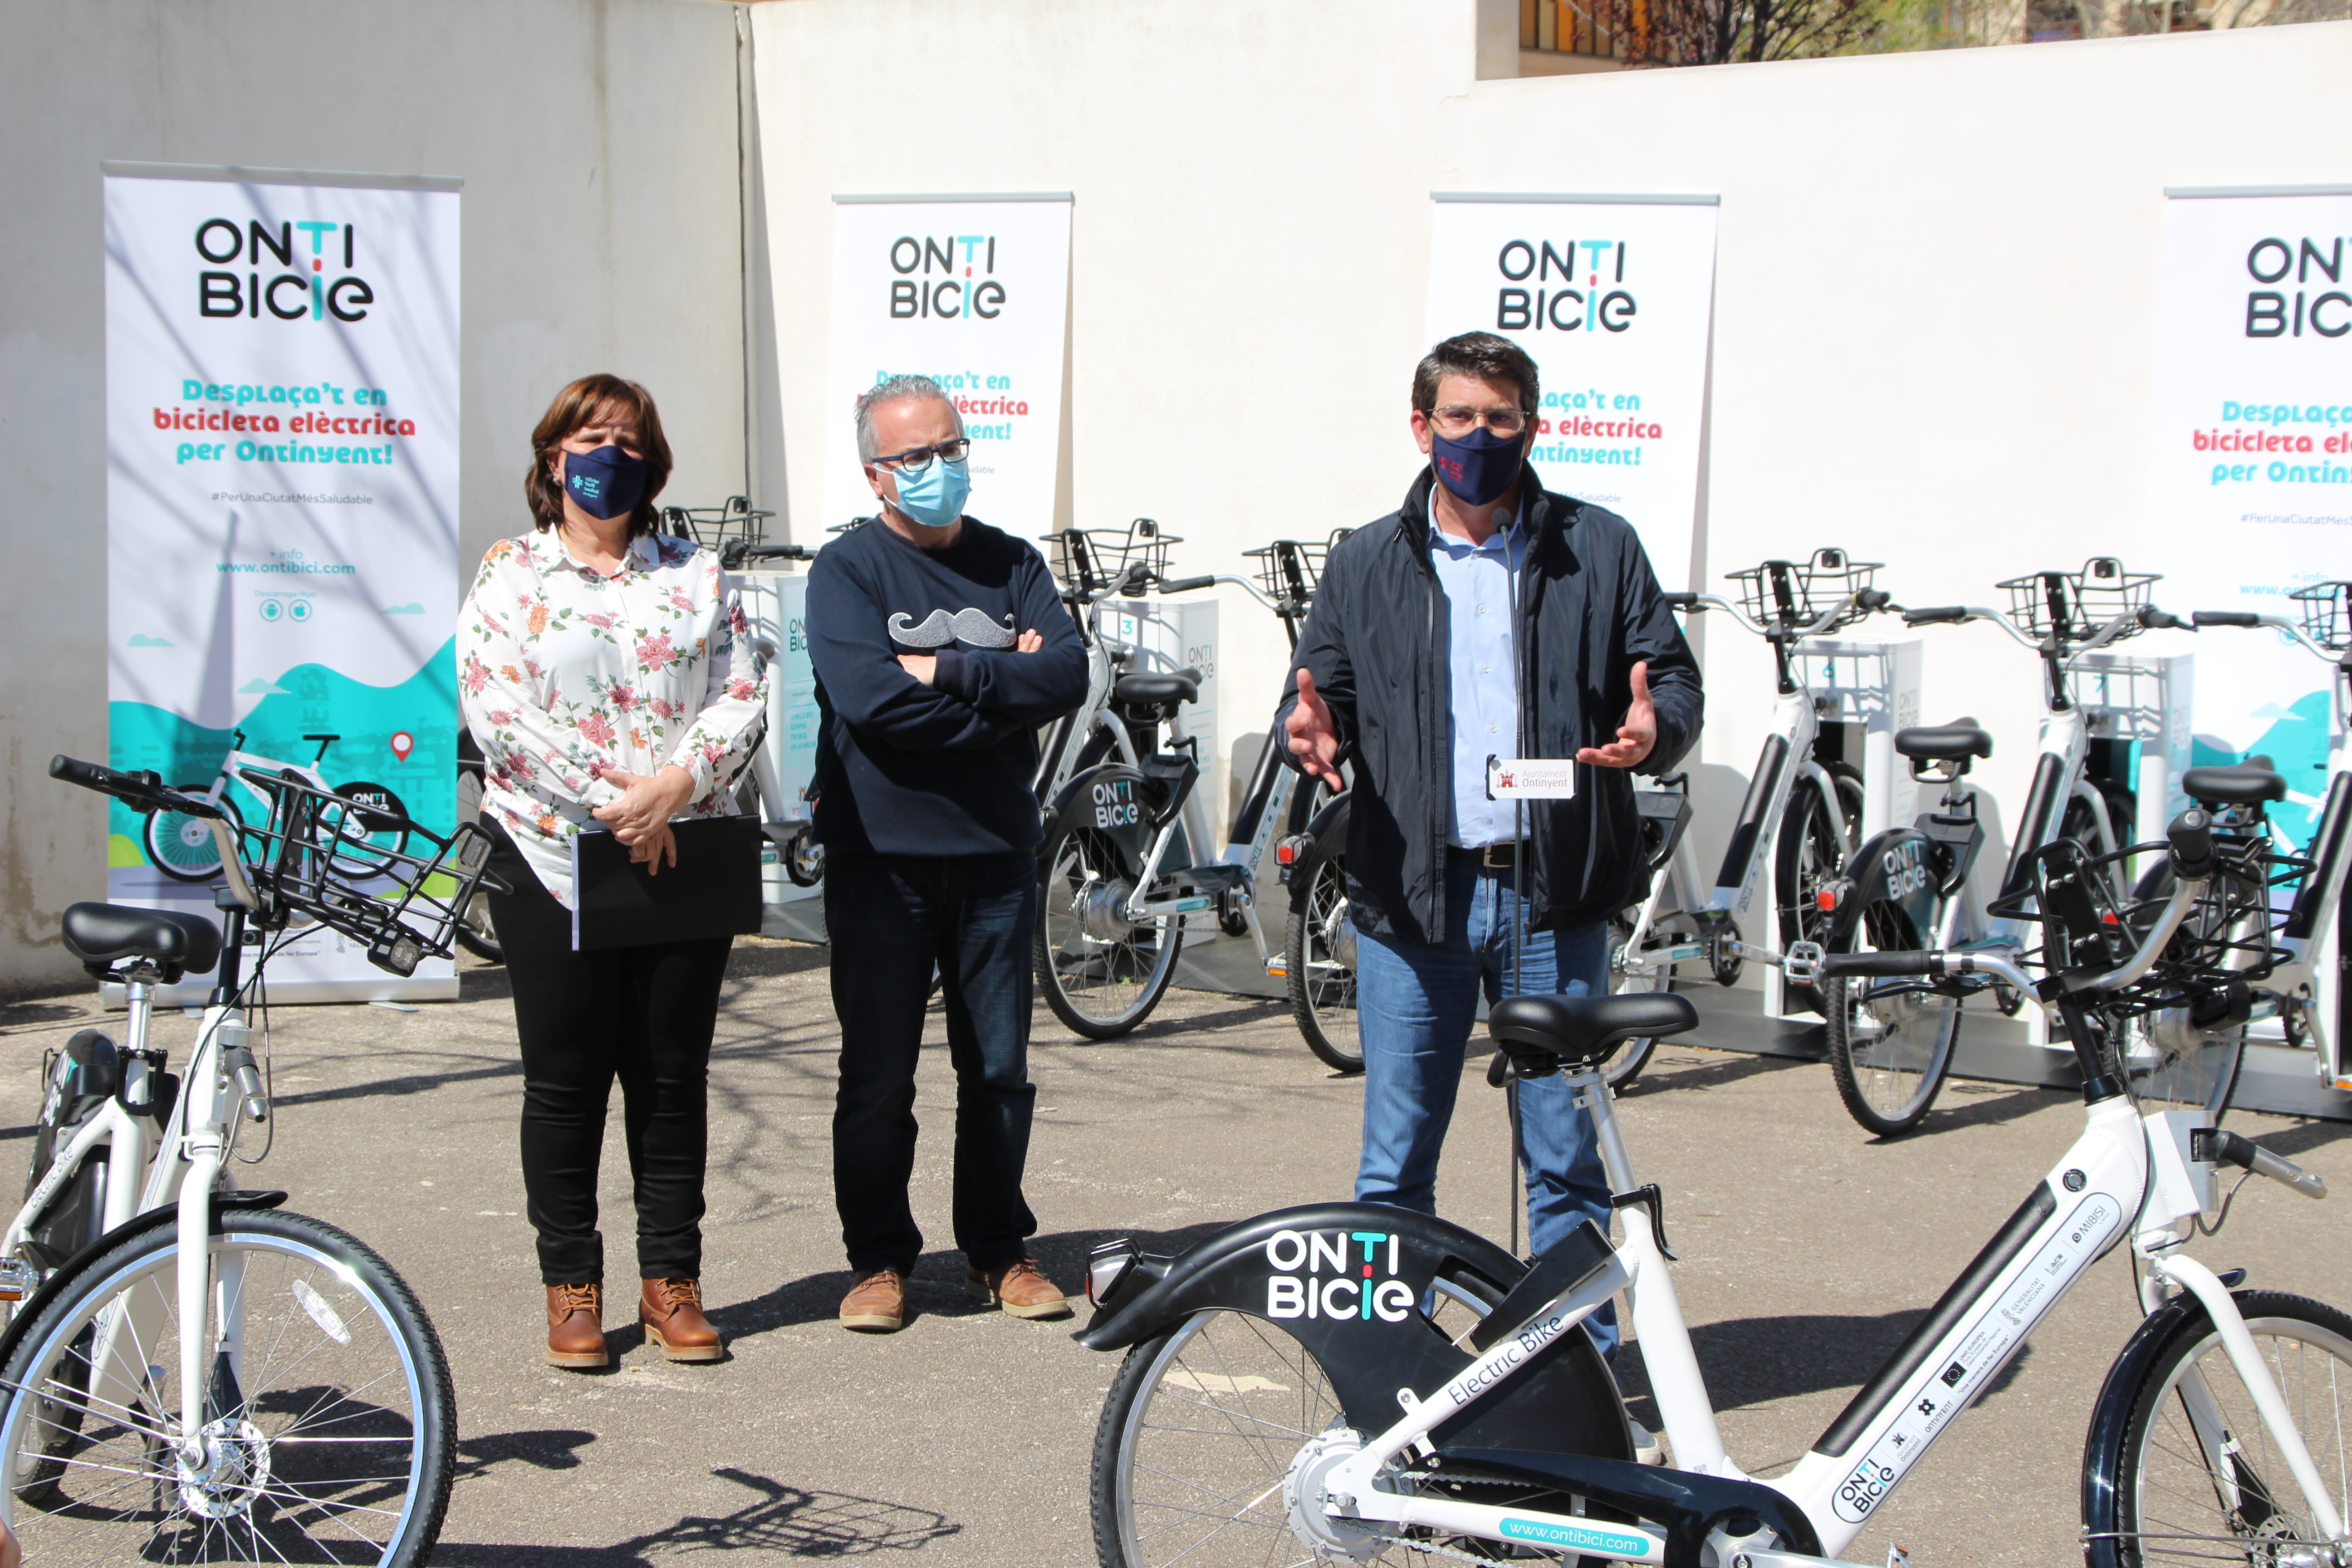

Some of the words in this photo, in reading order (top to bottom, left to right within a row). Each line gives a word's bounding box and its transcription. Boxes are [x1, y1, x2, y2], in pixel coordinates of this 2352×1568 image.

[195, 217, 353, 269] ONTI
[891, 235, 995, 274] ONTI
[1499, 239, 1626, 282] ONTI
[2247, 236, 2352, 284] ON
[986, 374, 1010, 389] en
[353, 387, 387, 405] en
[952, 395, 1029, 416] lèctrica
[1613, 394, 1641, 410] en
[153, 407, 279, 431] bicicleta
[289, 411, 416, 436] elèctrica
[1559, 415, 1663, 439] elèctrica
[176, 442, 225, 464] per
[235, 439, 393, 464] Ontinyent!
[2193, 427, 2314, 453] bicicleta
[1530, 441, 1642, 466] ntinyent!
[2211, 463, 2259, 485] per
[2268, 459, 2352, 483] Ontin
[279, 549, 303, 559] info
[216, 561, 355, 573] www.ontibici.com
[2304, 572, 2328, 583] info
[790, 617, 806, 634] ON
[1122, 620, 1132, 635] 3
[1188, 644, 1212, 663] ONTI
[1823, 662, 1834, 678] 6
[2093, 675, 2107, 692] 7
[1522, 769, 1568, 781] Ajuntament
[1522, 778, 1568, 789] Ontinyent
[1093, 780, 1132, 805] ONTI
[1882, 840, 1920, 874] ONTI
[31, 1167, 57, 1209] Electric
[2079, 1205, 2107, 1236] MIBISI
[1266, 1229, 1399, 1276] ONTI
[2011, 1277, 2041, 1311] GENERALITAT
[2016, 1283, 2046, 1314] VALENCIANA
[1958, 1349, 1970, 1361] UNIÓ
[1967, 1331, 1986, 1352] EUROPEA
[1970, 1341, 1983, 1356] Europeu
[1447, 1348, 1521, 1406] Electric
[1517, 1317, 1564, 1353] Bike
[1968, 1366, 1984, 1385] manera
[1982, 1360, 1988, 1368] de
[1987, 1352, 1995, 1362] fer
[1896, 1434, 1918, 1459] Ajuntament
[1900, 1437, 1922, 1463] Ontinyent
[1841, 1458, 1880, 1501] ONTI
[1509, 1523, 1638, 1552] www.ontibici.com
